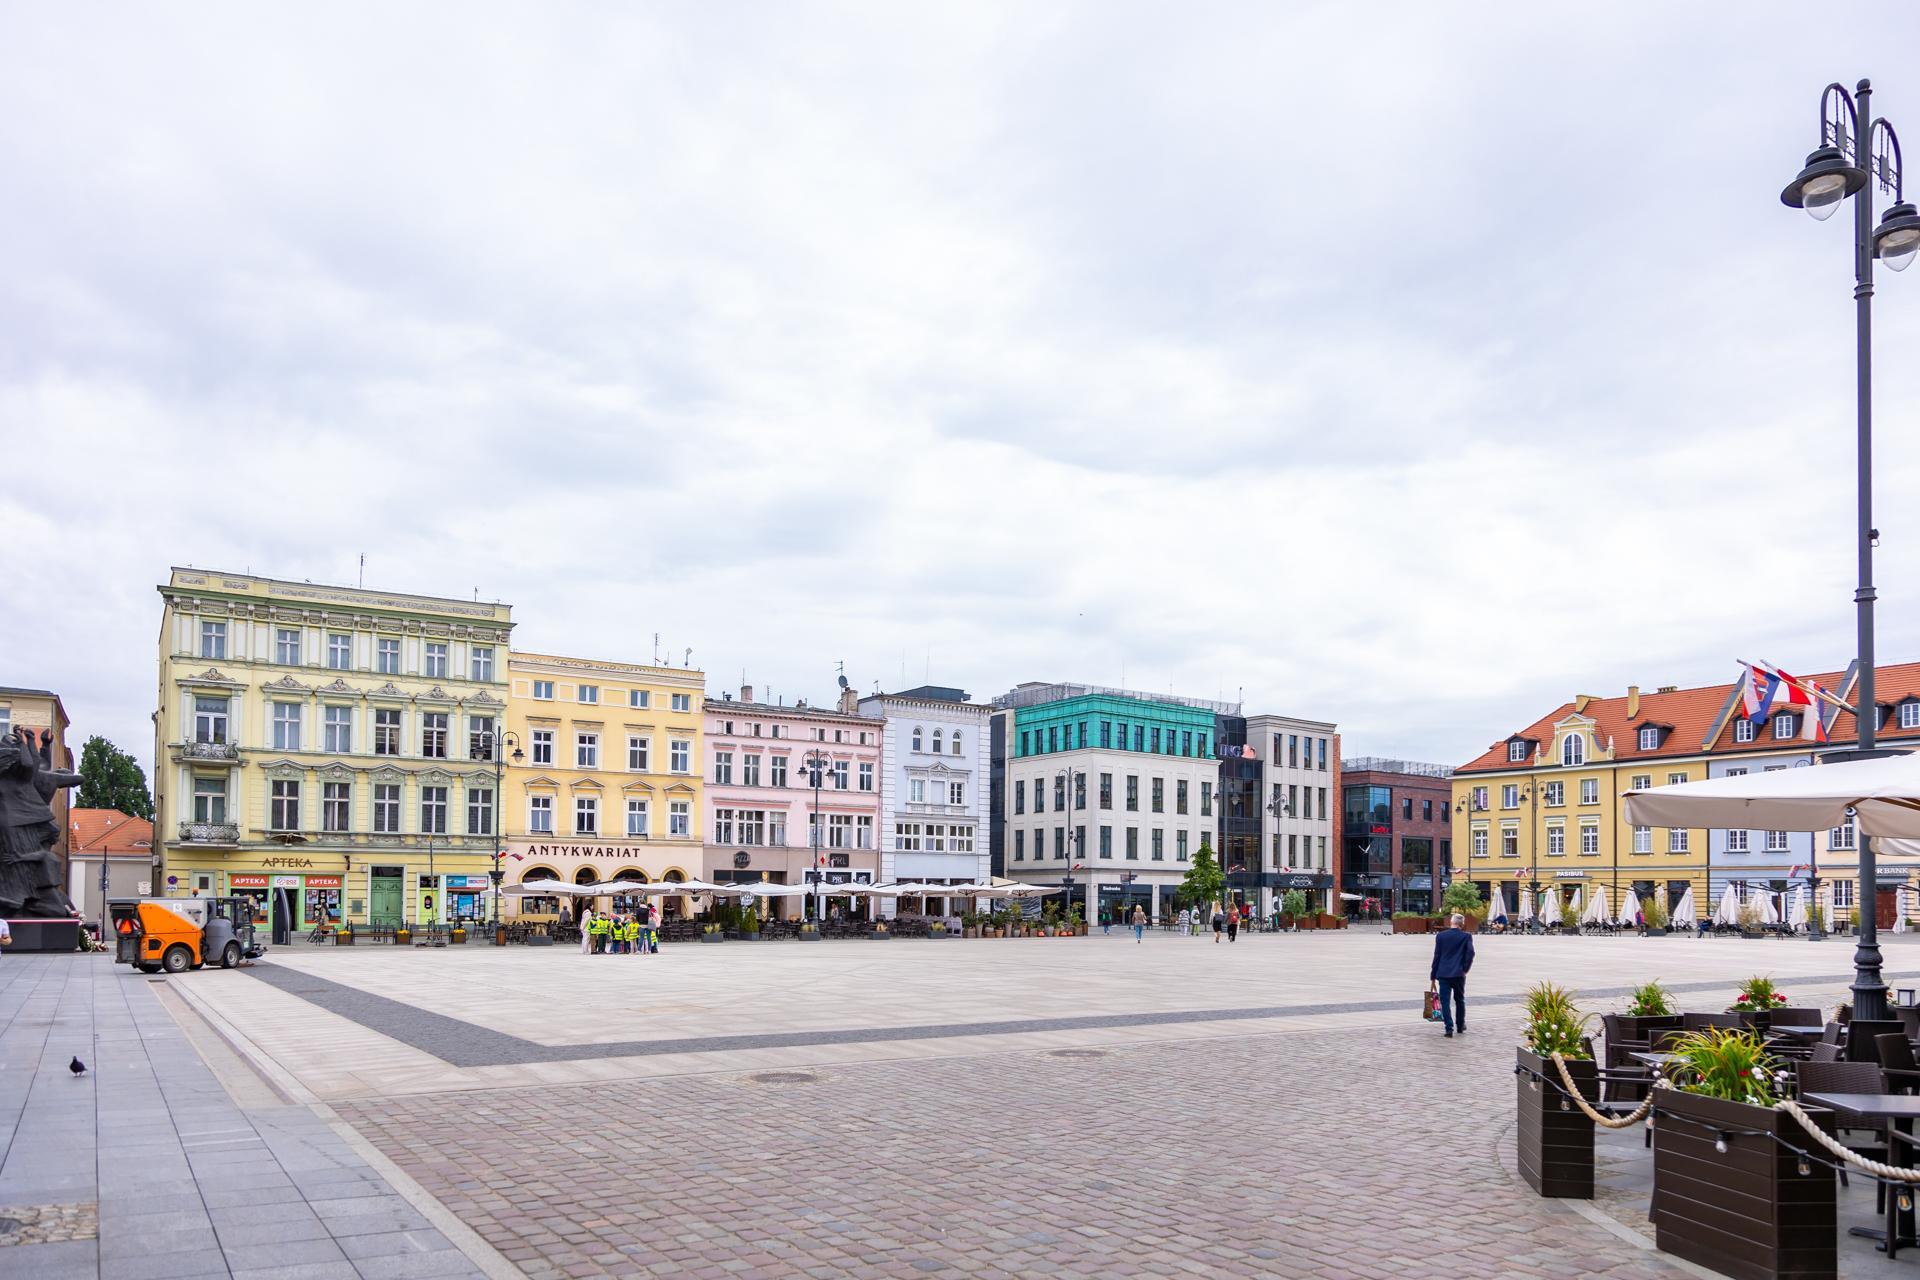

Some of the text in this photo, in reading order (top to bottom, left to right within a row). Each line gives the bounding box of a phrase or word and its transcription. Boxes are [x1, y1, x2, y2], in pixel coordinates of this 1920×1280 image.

[1220, 744, 1241, 757] ING
[528, 845, 640, 858] ANTYKWARIAT
[262, 858, 313, 868] APTEKA
